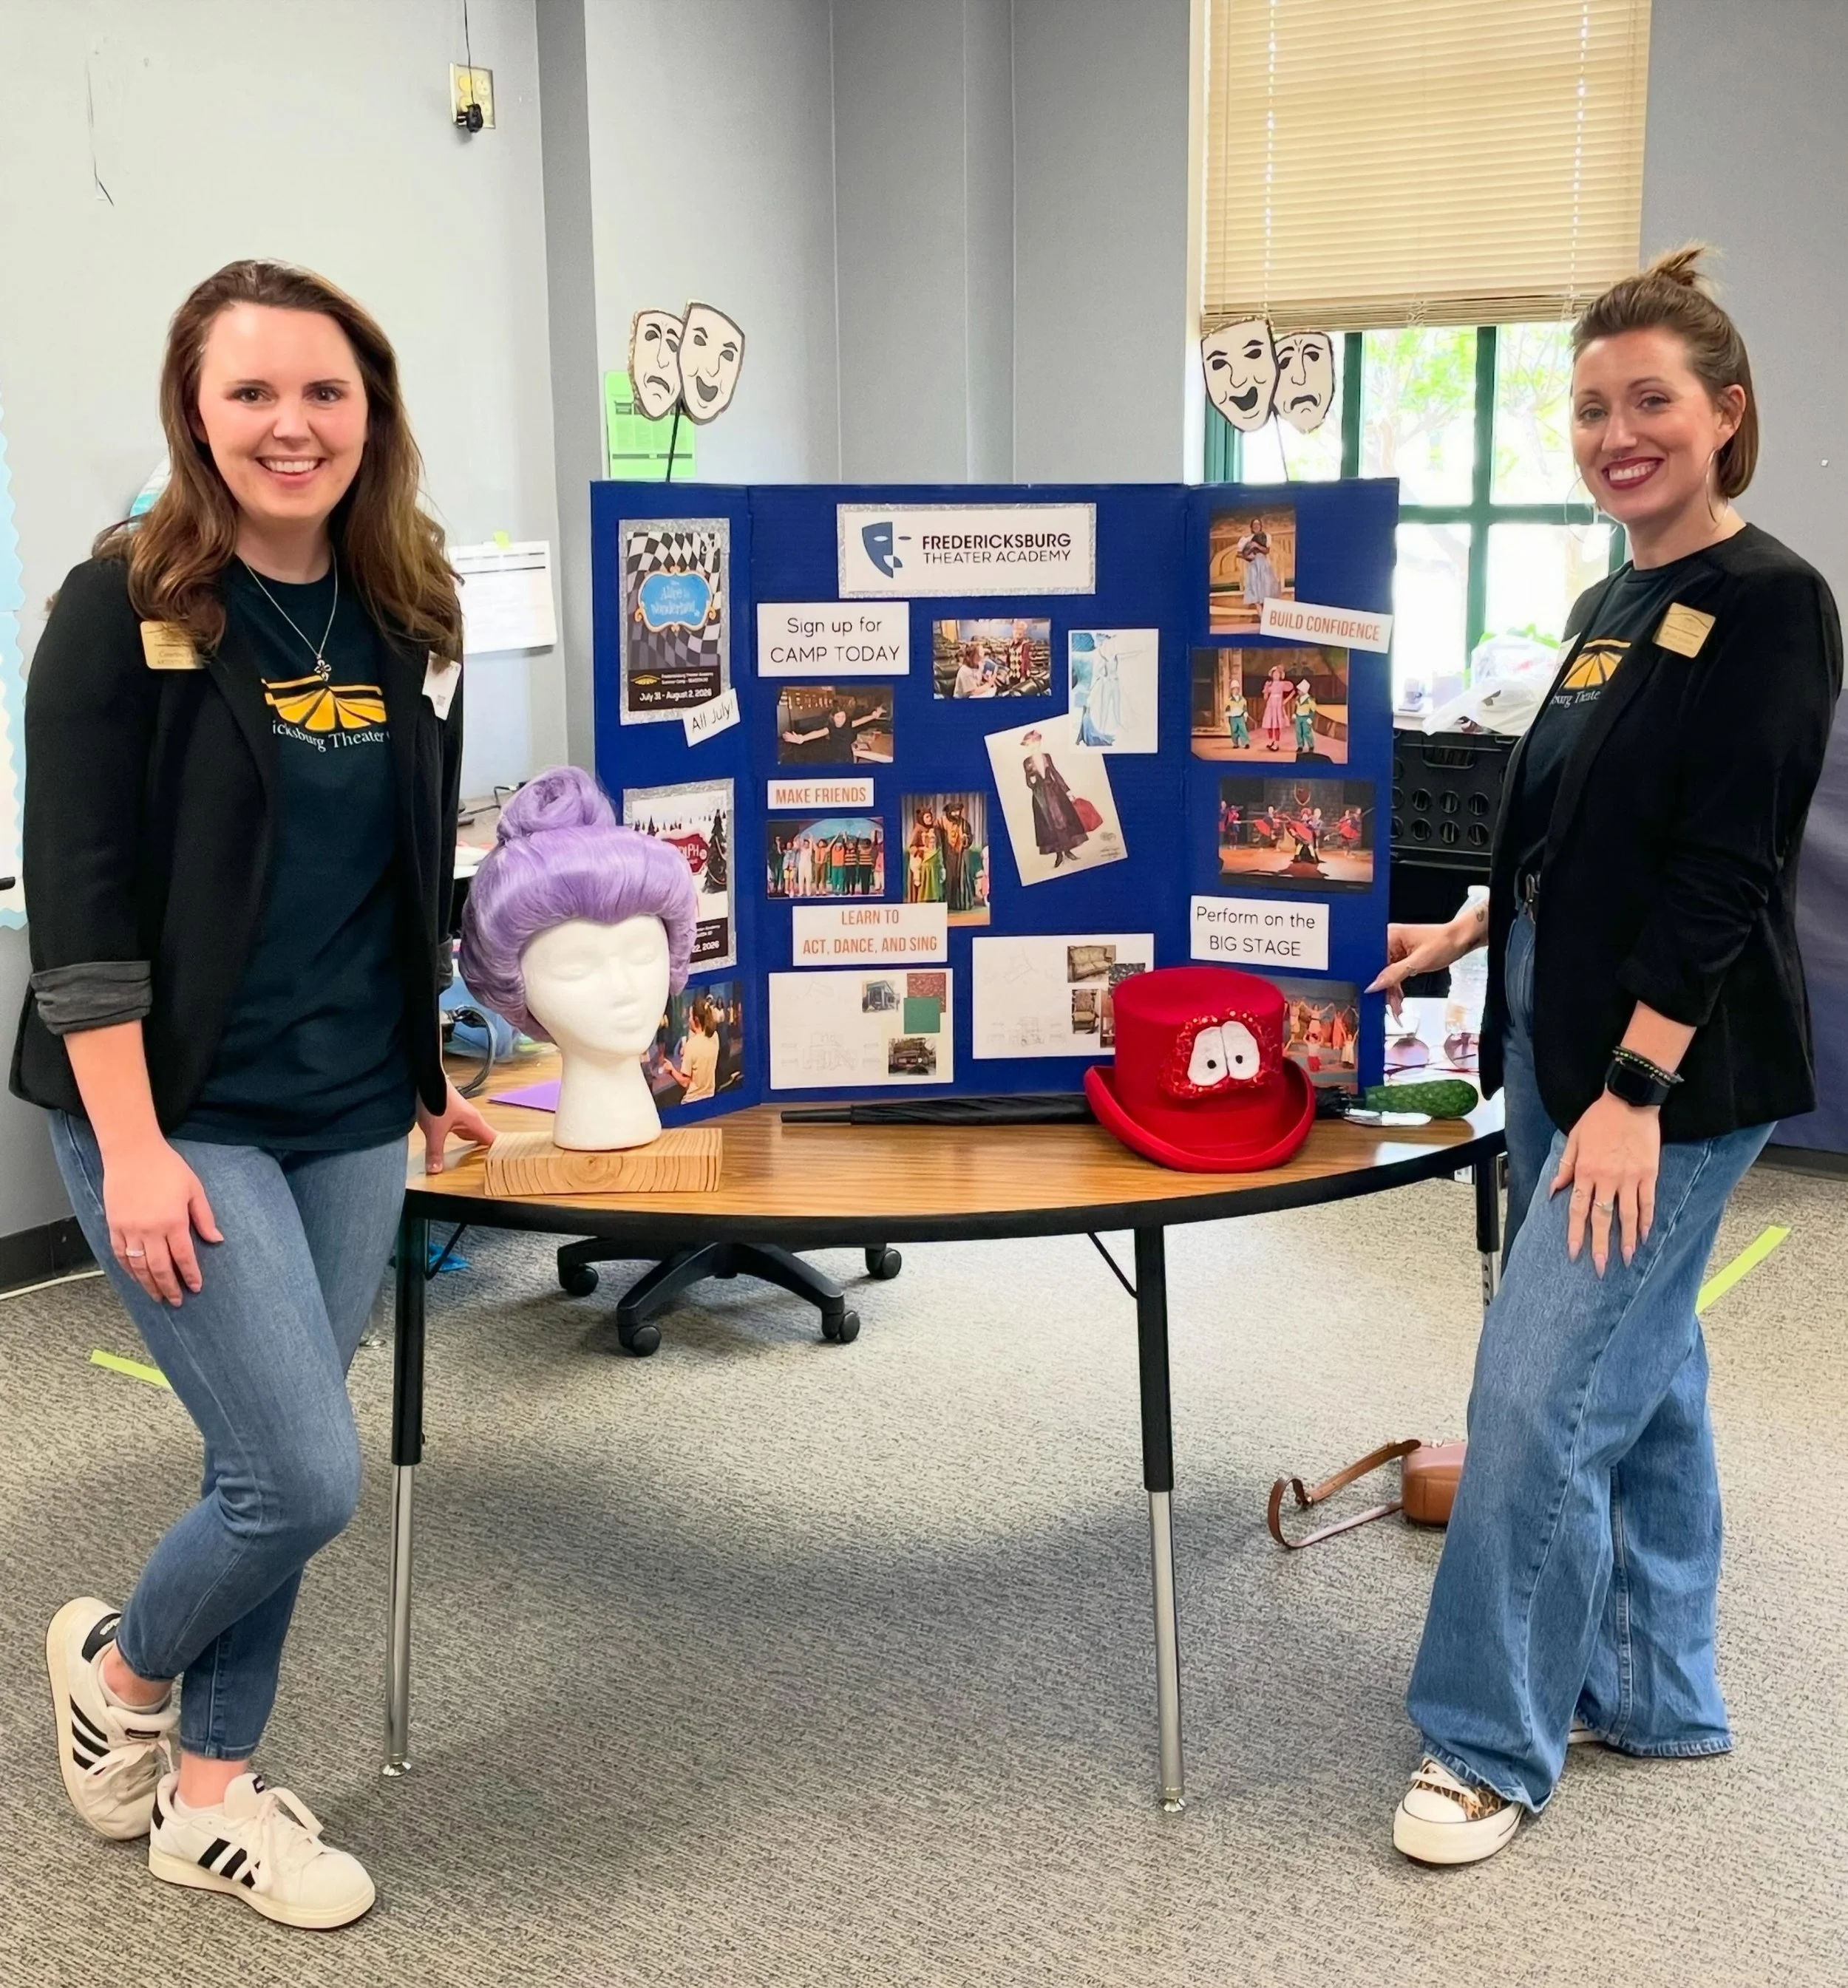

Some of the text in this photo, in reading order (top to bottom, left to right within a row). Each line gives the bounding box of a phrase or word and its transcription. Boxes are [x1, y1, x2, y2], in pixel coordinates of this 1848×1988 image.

[922, 533, 1071, 551] FREDERICKSBURG
[923, 549, 1071, 565] THEATER ACADEMY
[787, 616, 882, 638] Sign up for
[1269, 610, 1381, 641] BUILD CONFIDENCE
[770, 645, 900, 664] CAMP TODAY
[639, 692, 653, 702] July
[654, 692, 662, 701] 31
[666, 690, 688, 701] August
[695, 688, 712, 697] 2026
[691, 698, 734, 733] All July!
[271, 720, 384, 752] icksburg Theater
[775, 786, 867, 805] MAKE FRIENDS
[841, 909, 900, 926] LEARN TO
[1197, 905, 1316, 930] Perform on the
[702, 940, 720, 951] 2026
[803, 936, 937, 956] ACT, DANCE, AND SING
[1209, 935, 1301, 958] BIG STAGE
